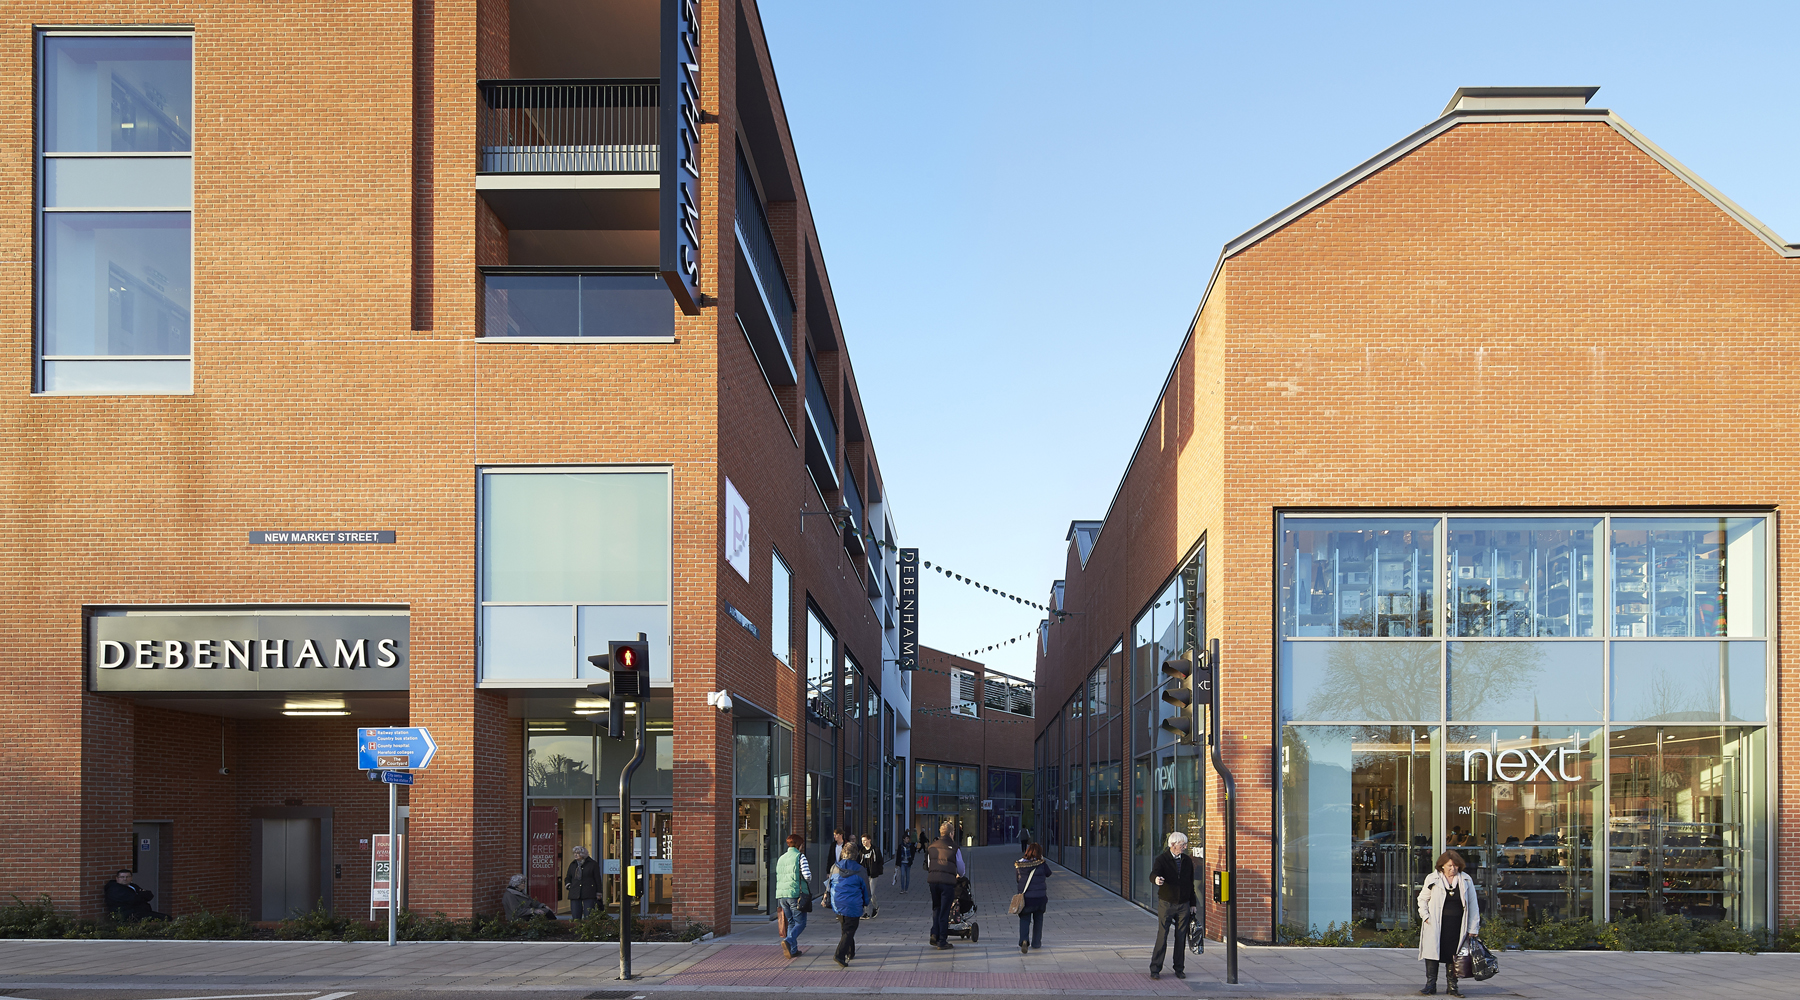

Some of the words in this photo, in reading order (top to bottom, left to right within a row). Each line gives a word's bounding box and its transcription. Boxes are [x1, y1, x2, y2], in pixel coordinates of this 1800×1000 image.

[682, 0, 700, 287] ENHAMS
[264, 532, 289, 542] NEW
[291, 532, 335, 542] MARKET
[338, 532, 379, 542] STREET
[903, 552, 915, 666] DEBENHAMS
[99, 638, 398, 668] DEBENHAMS
[1464, 747, 1582, 781] next
[1458, 806, 1471, 815] PAY
[532, 832, 554, 840] new
[532, 844, 554, 854] FREE
